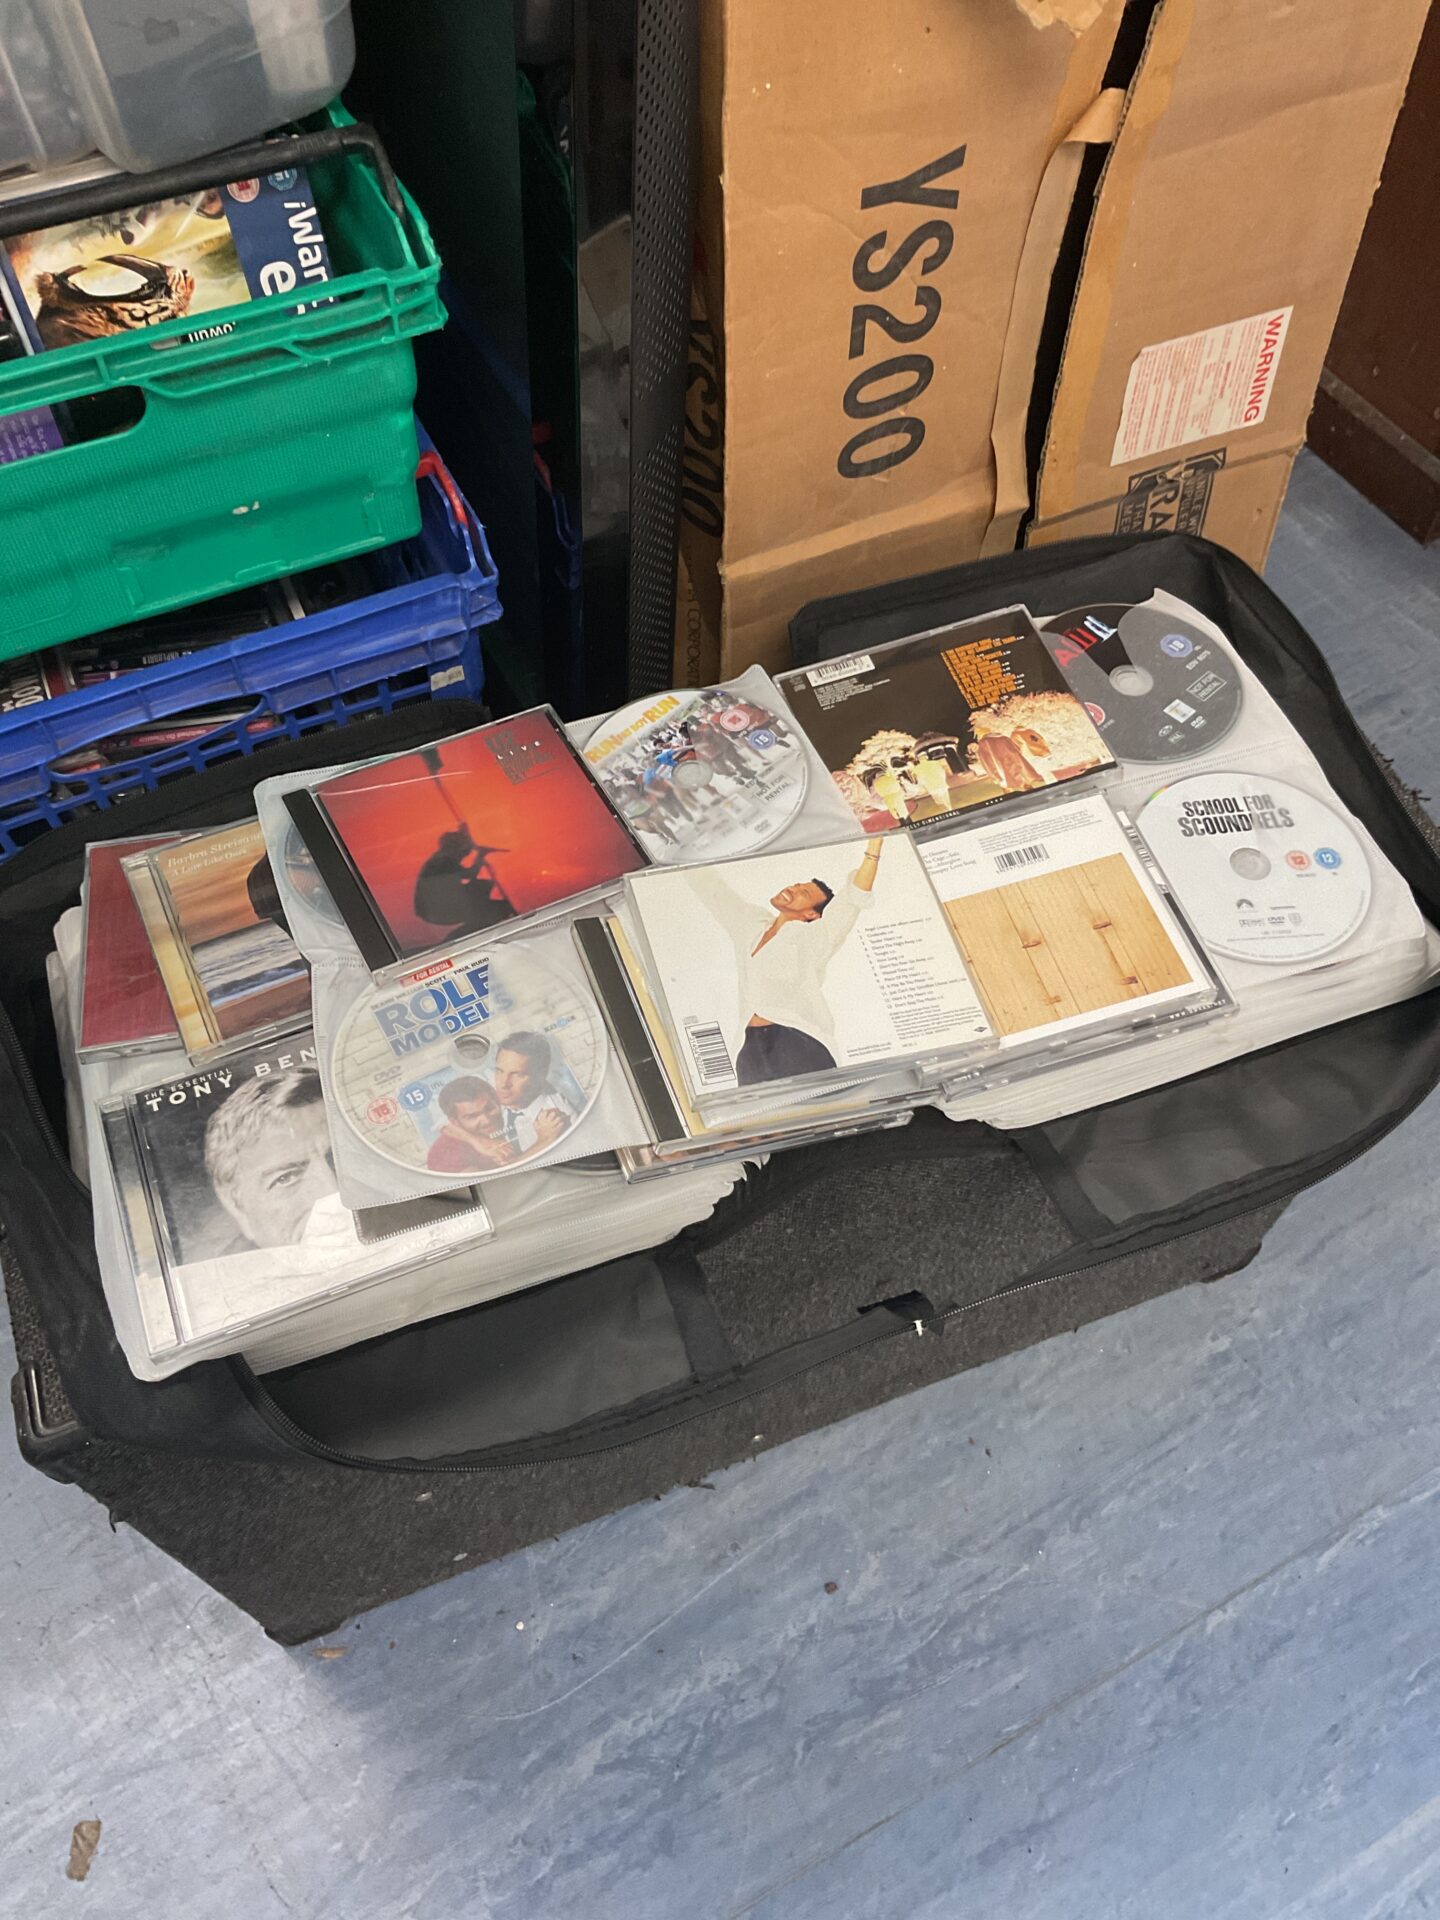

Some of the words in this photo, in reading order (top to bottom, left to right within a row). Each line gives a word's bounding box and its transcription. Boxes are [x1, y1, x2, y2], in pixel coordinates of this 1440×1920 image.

[837, 144, 967, 478] YS200
[1244, 313, 1285, 423] WARNING
[1198, 680, 1221, 700] RENTAL
[642, 696, 680, 724] RUN
[755, 736, 769, 747] 15
[755, 784, 770, 799] NOT
[766, 781, 790, 801] RENTAL
[1182, 797, 1243, 817] SCHOOL
[1246, 793, 1276, 812] FOR
[1177, 808, 1295, 838] SCOUNDRELS
[1320, 852, 1336, 865] 12
[415, 968, 429, 981] FOR
[429, 961, 450, 977] RENTAL
[425, 975, 447, 987] SCOTT
[453, 965, 470, 976] PAUL
[471, 957, 489, 968] RUDD
[373, 965, 494, 1037] ROLE
[391, 987, 513, 1057] MODELS
[144, 1089, 164, 1100] THE
[170, 1067, 232, 1091] ESSENTIAL
[146, 1075, 233, 1112] TONY
[405, 1089, 425, 1106] 15
